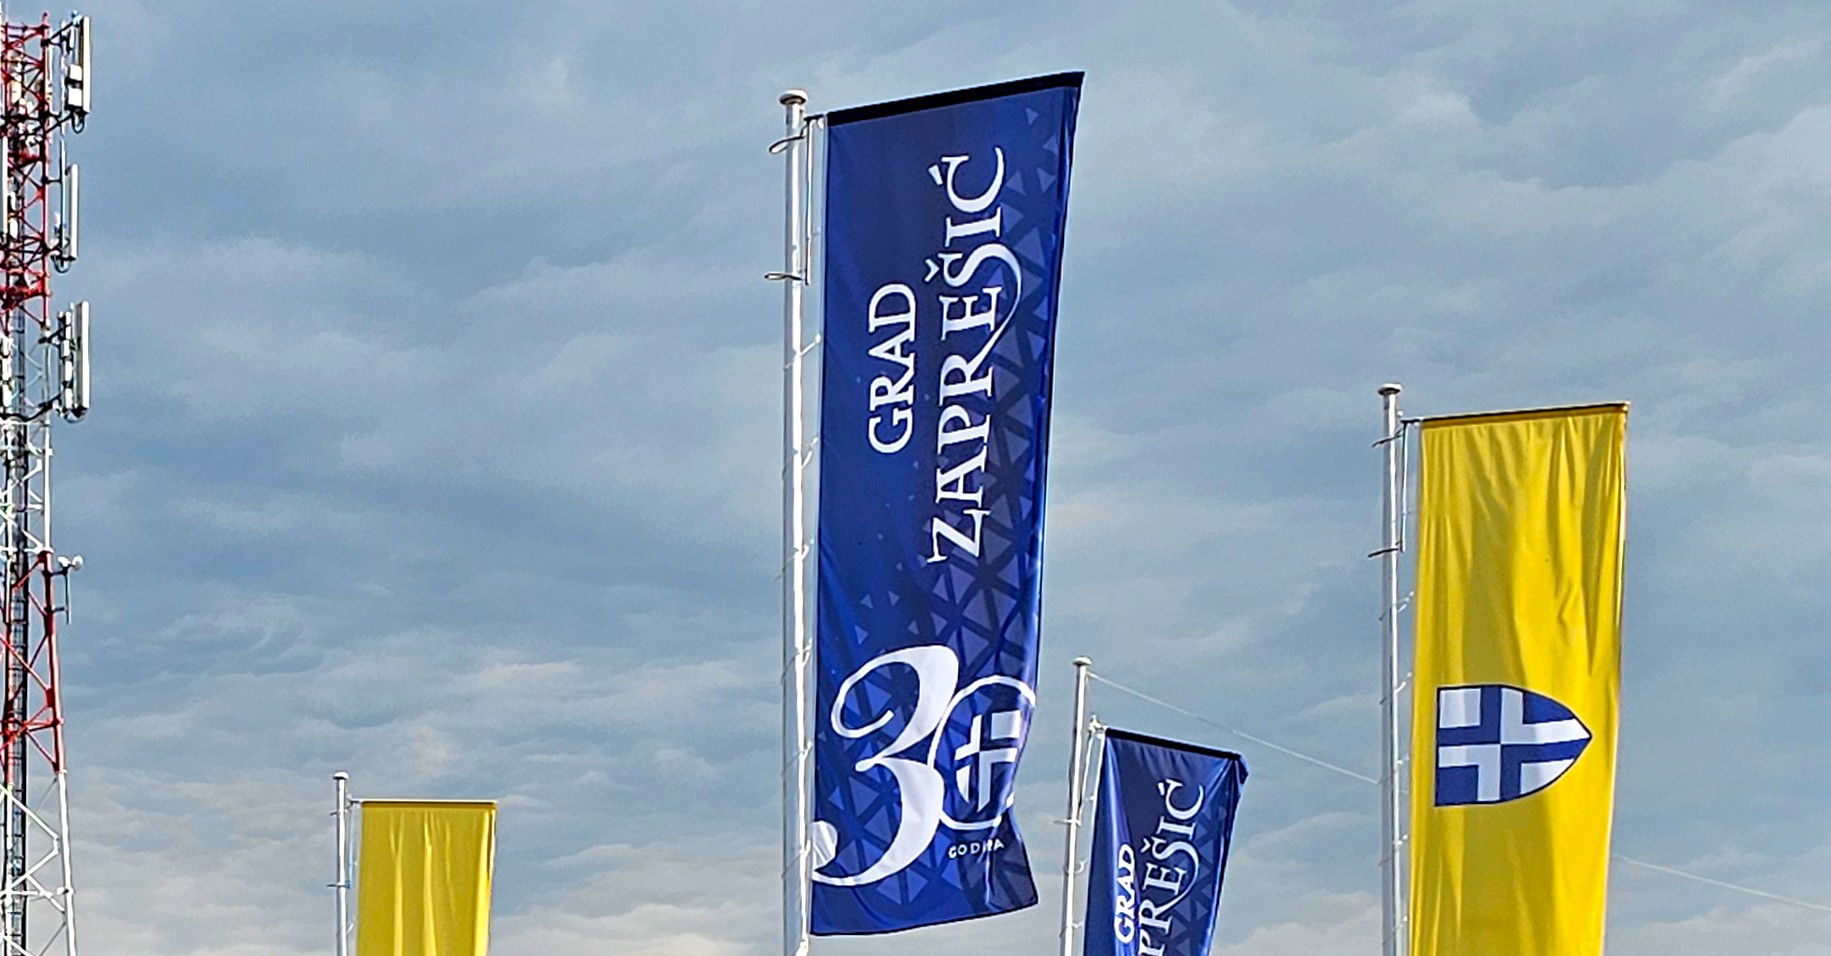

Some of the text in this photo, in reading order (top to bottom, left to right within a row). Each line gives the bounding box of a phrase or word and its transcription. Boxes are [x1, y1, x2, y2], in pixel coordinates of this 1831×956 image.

[867, 283, 917, 454] GRAD
[923, 147, 1023, 564] ZAPREŠIĆ
[1114, 843, 1136, 944] GRAD
